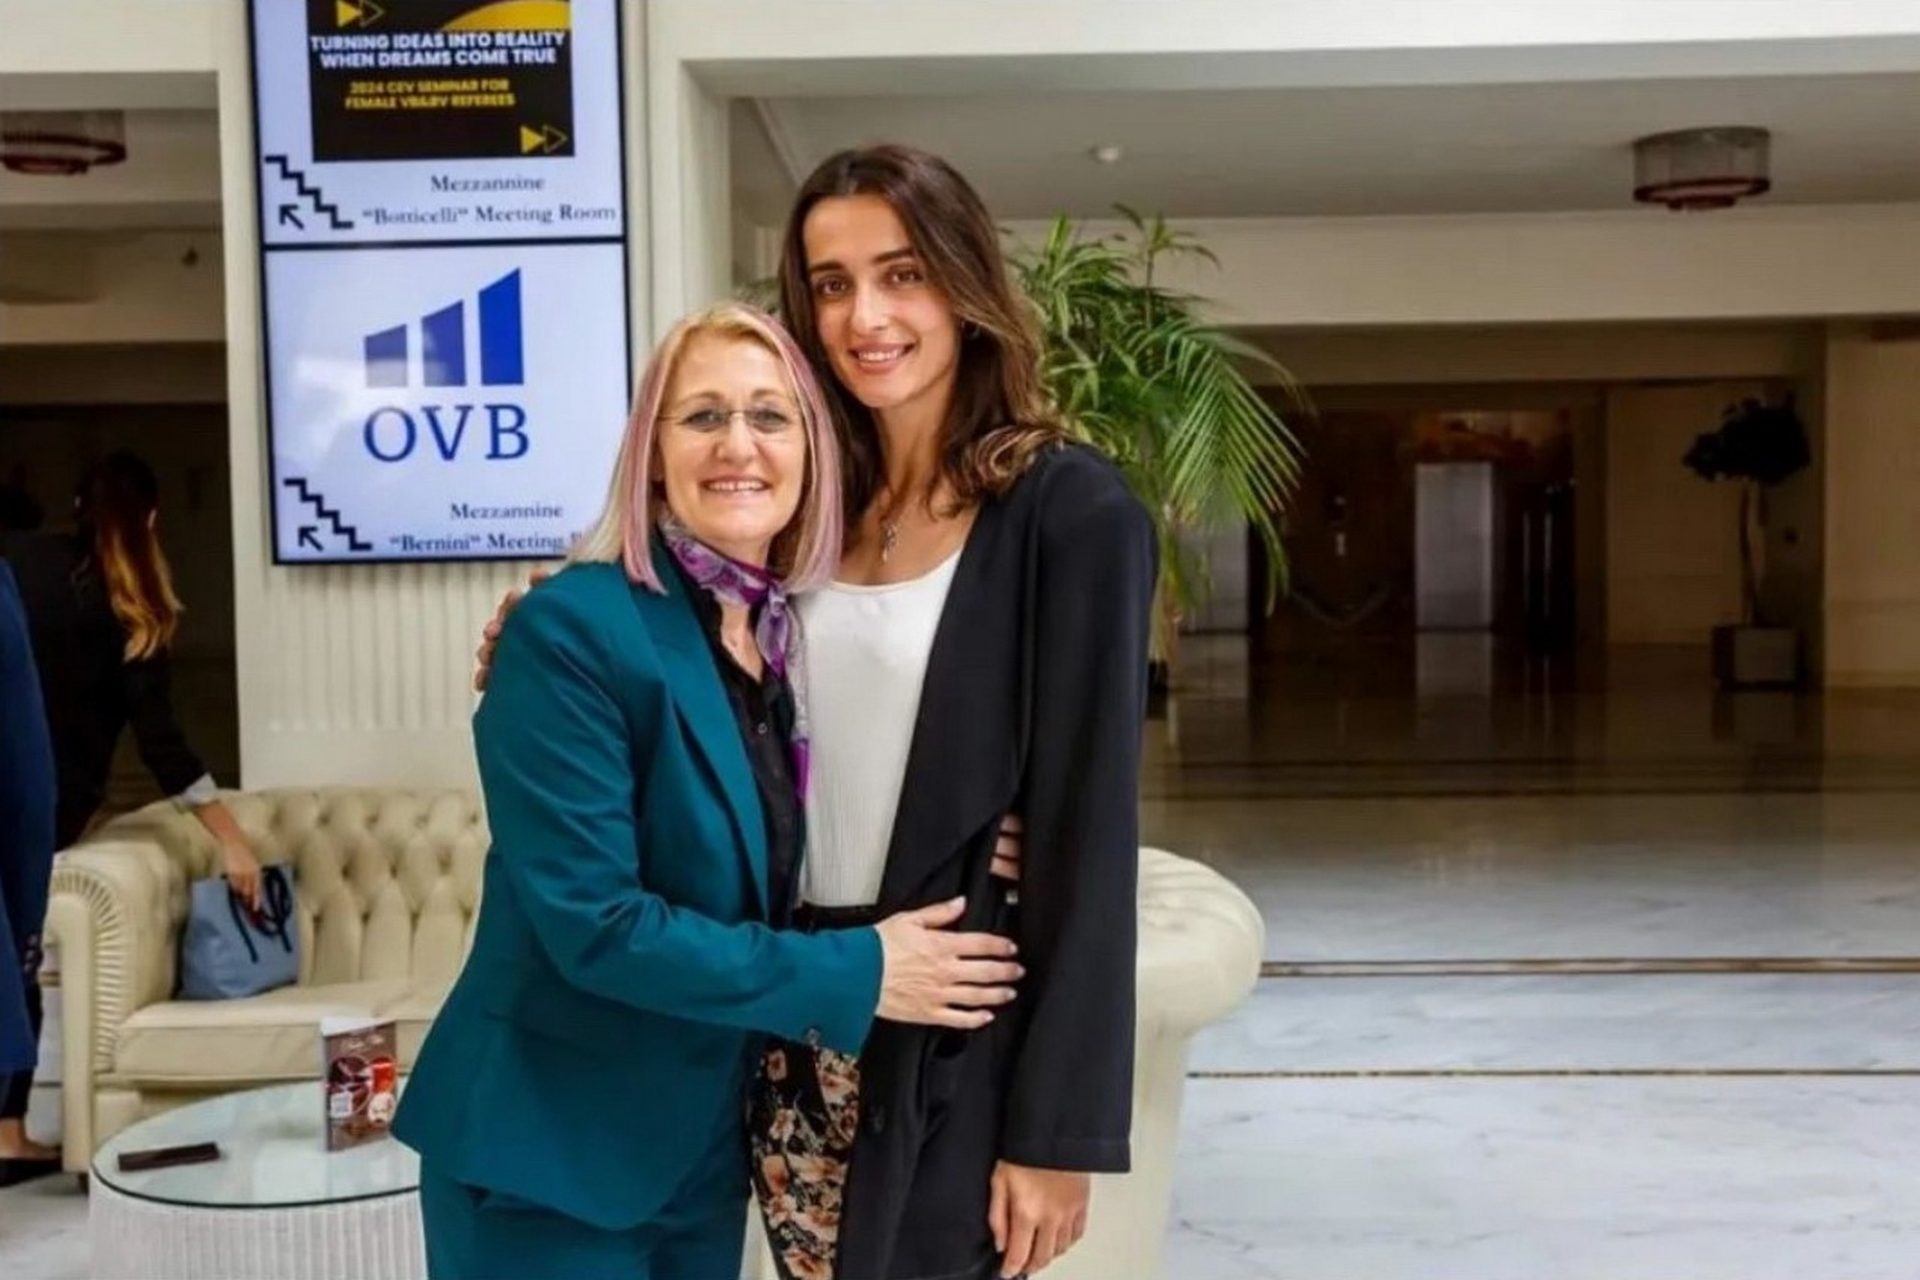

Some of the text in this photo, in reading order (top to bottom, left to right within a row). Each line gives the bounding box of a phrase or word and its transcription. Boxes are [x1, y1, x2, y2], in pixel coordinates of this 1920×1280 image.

[311, 31, 565, 51] TURNING IDEAS INTO REALITY
[320, 47, 557, 68] WHEN DREAMS COME TRUE
[417, 79, 479, 93] SEMINAR
[480, 78, 510, 91] FOR
[345, 96, 398, 110] FEMALE
[450, 92, 516, 107] REFEREES
[430, 175, 546, 193] Mezzannine
[474, 205, 553, 224] Meeting
[558, 203, 616, 220] Room
[363, 403, 530, 463] OVB
[449, 503, 564, 520] Mezzannine
[486, 532, 566, 553] Meeting
